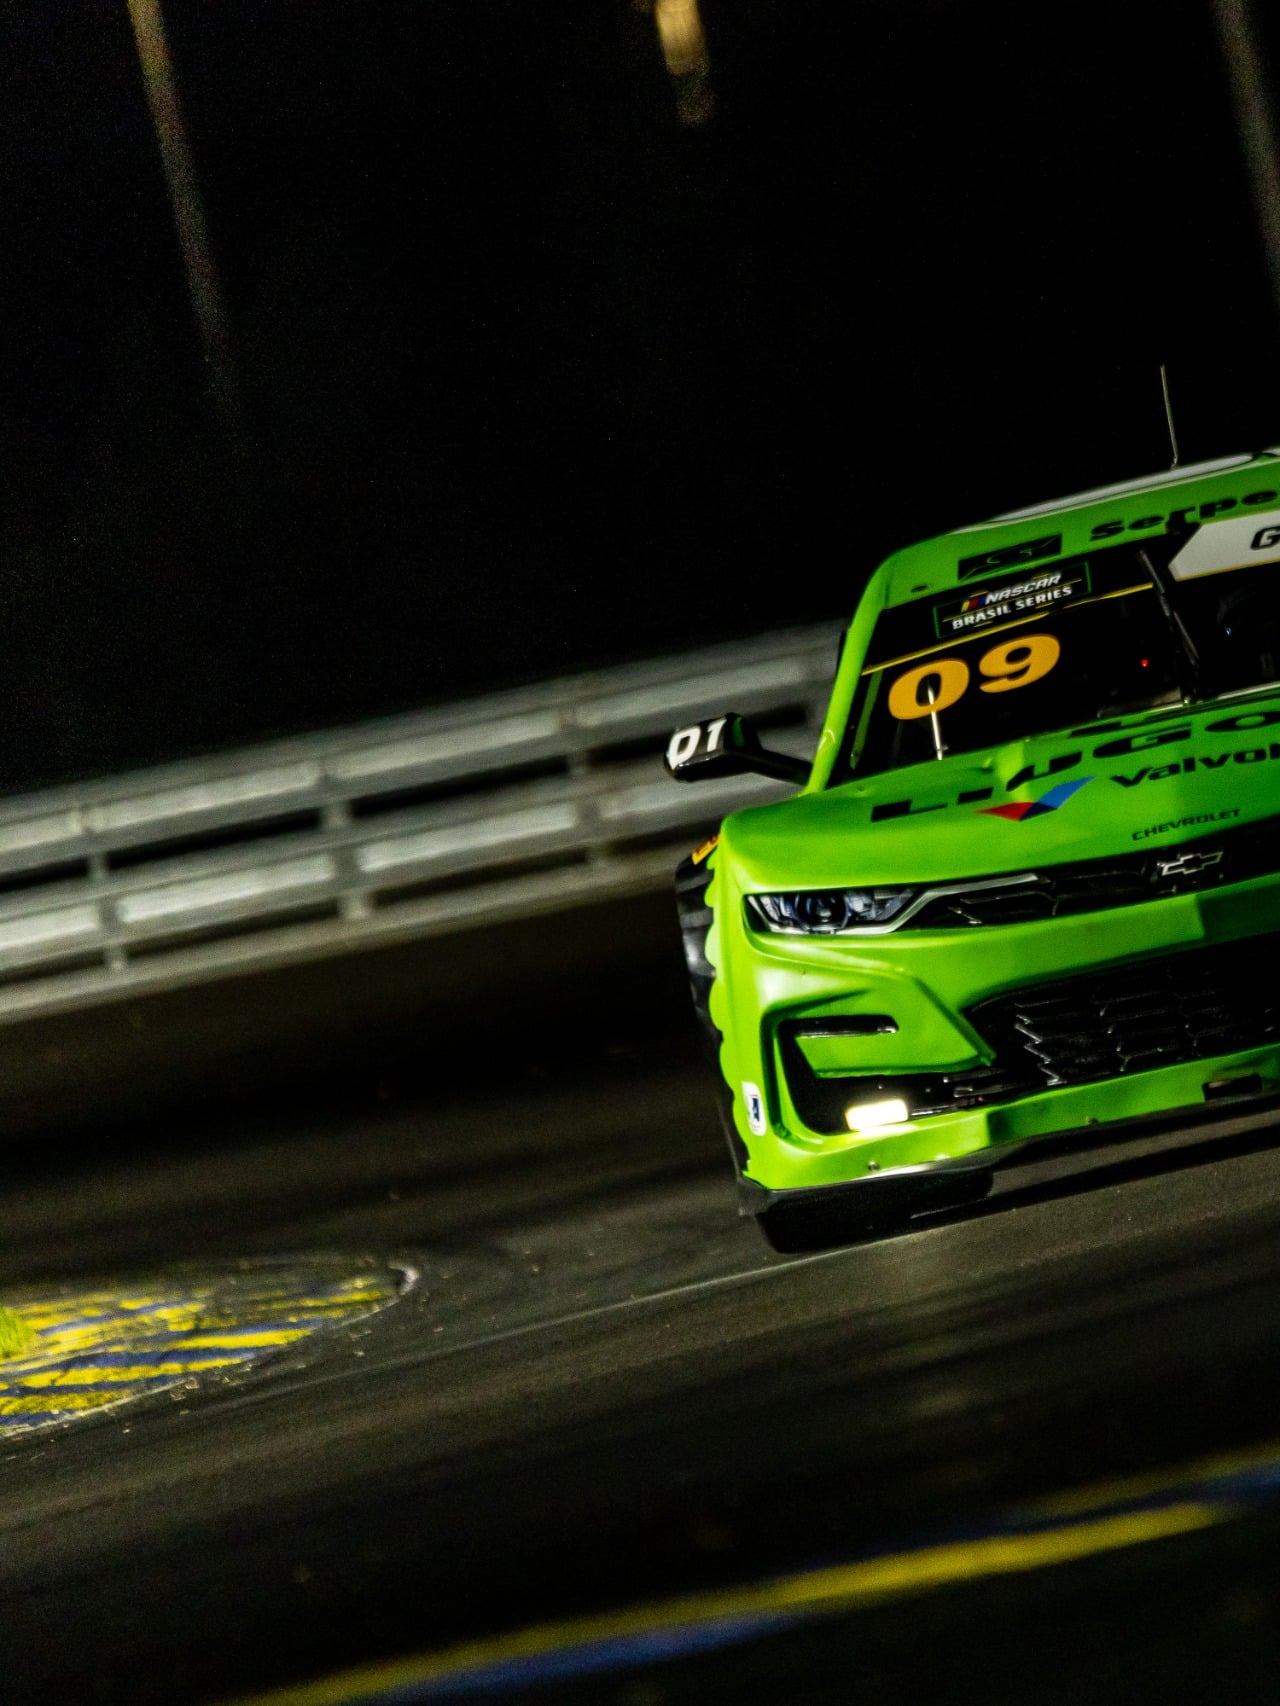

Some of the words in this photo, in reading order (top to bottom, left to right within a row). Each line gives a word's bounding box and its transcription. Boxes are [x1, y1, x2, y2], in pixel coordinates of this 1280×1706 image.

[951, 605, 1012, 630] BRASIL
[1015, 586, 1073, 611] SERIES
[985, 572, 1062, 605] NASCAR
[887, 634, 1062, 720] 09
[667, 717, 728, 769] 01
[1132, 808, 1241, 841] CHEVROLET
